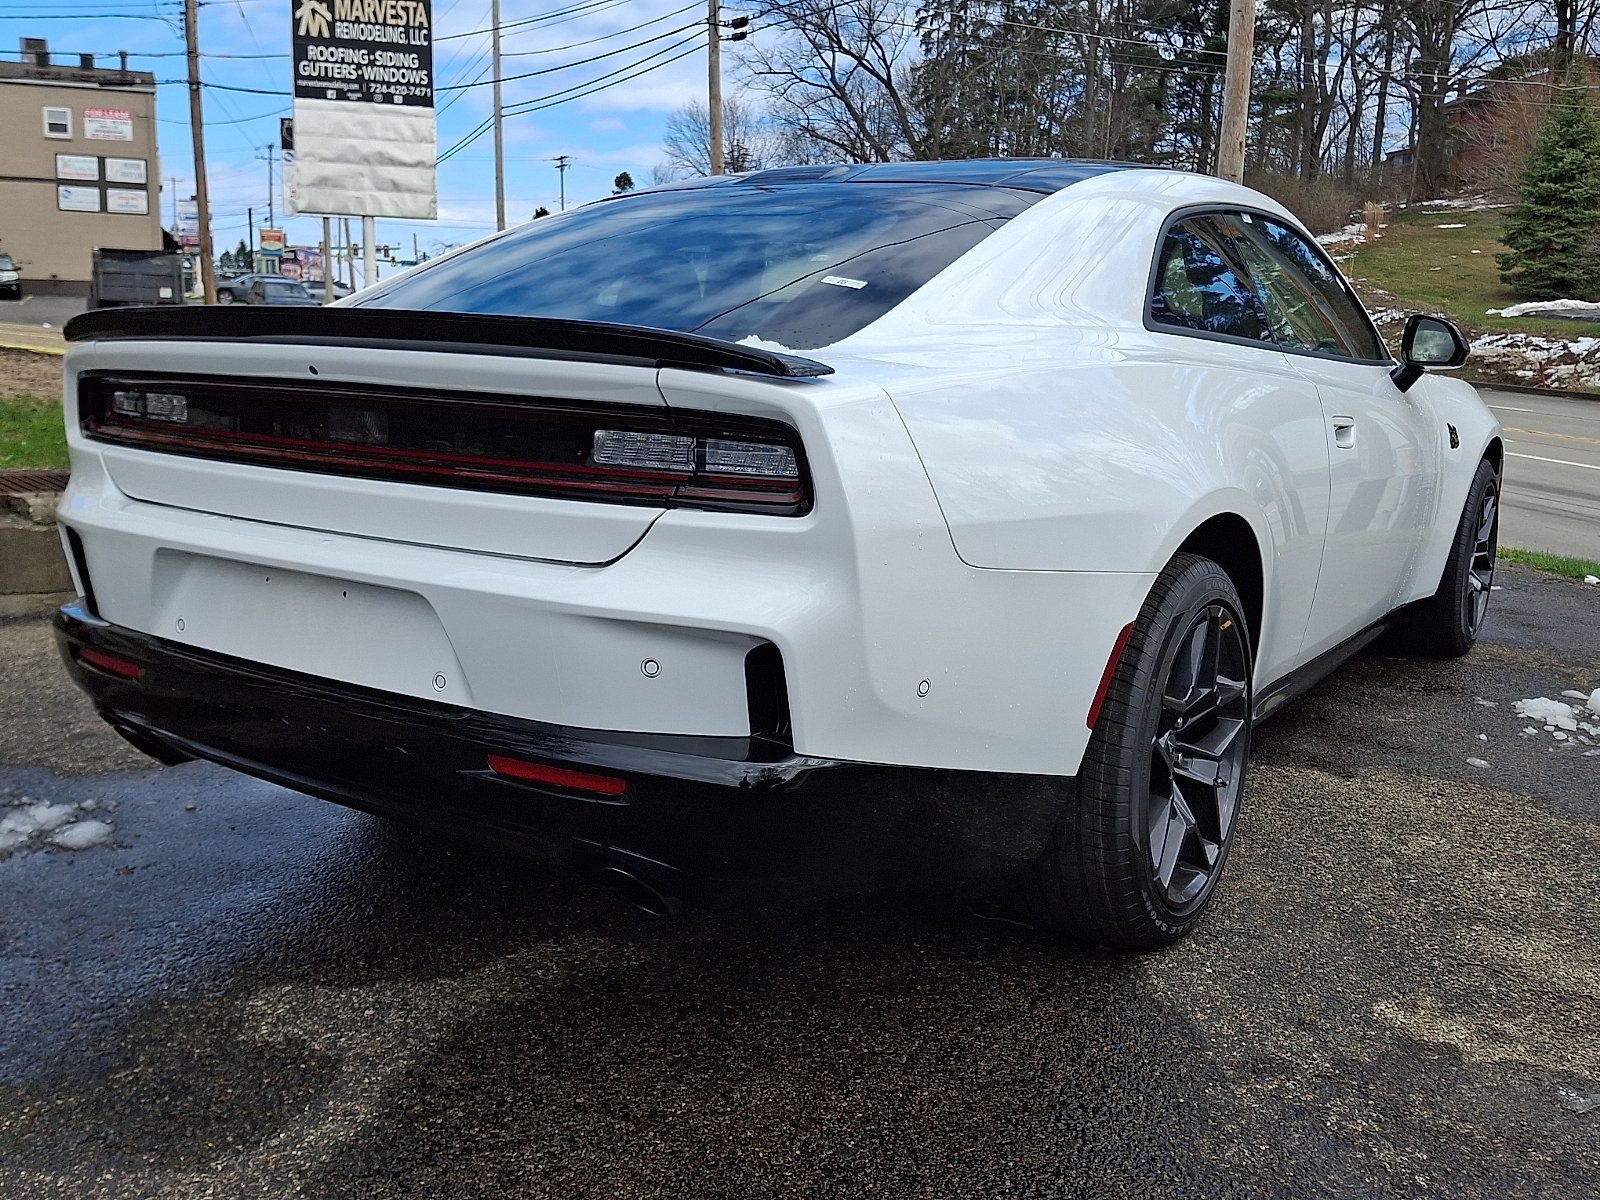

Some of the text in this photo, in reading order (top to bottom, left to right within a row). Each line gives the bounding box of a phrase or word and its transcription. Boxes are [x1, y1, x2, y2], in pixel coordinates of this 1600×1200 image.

[334, 0, 429, 28] MARVESTA
[334, 21, 429, 47] REMODELING, LLC
[369, 83, 432, 97] 724-420-7471
